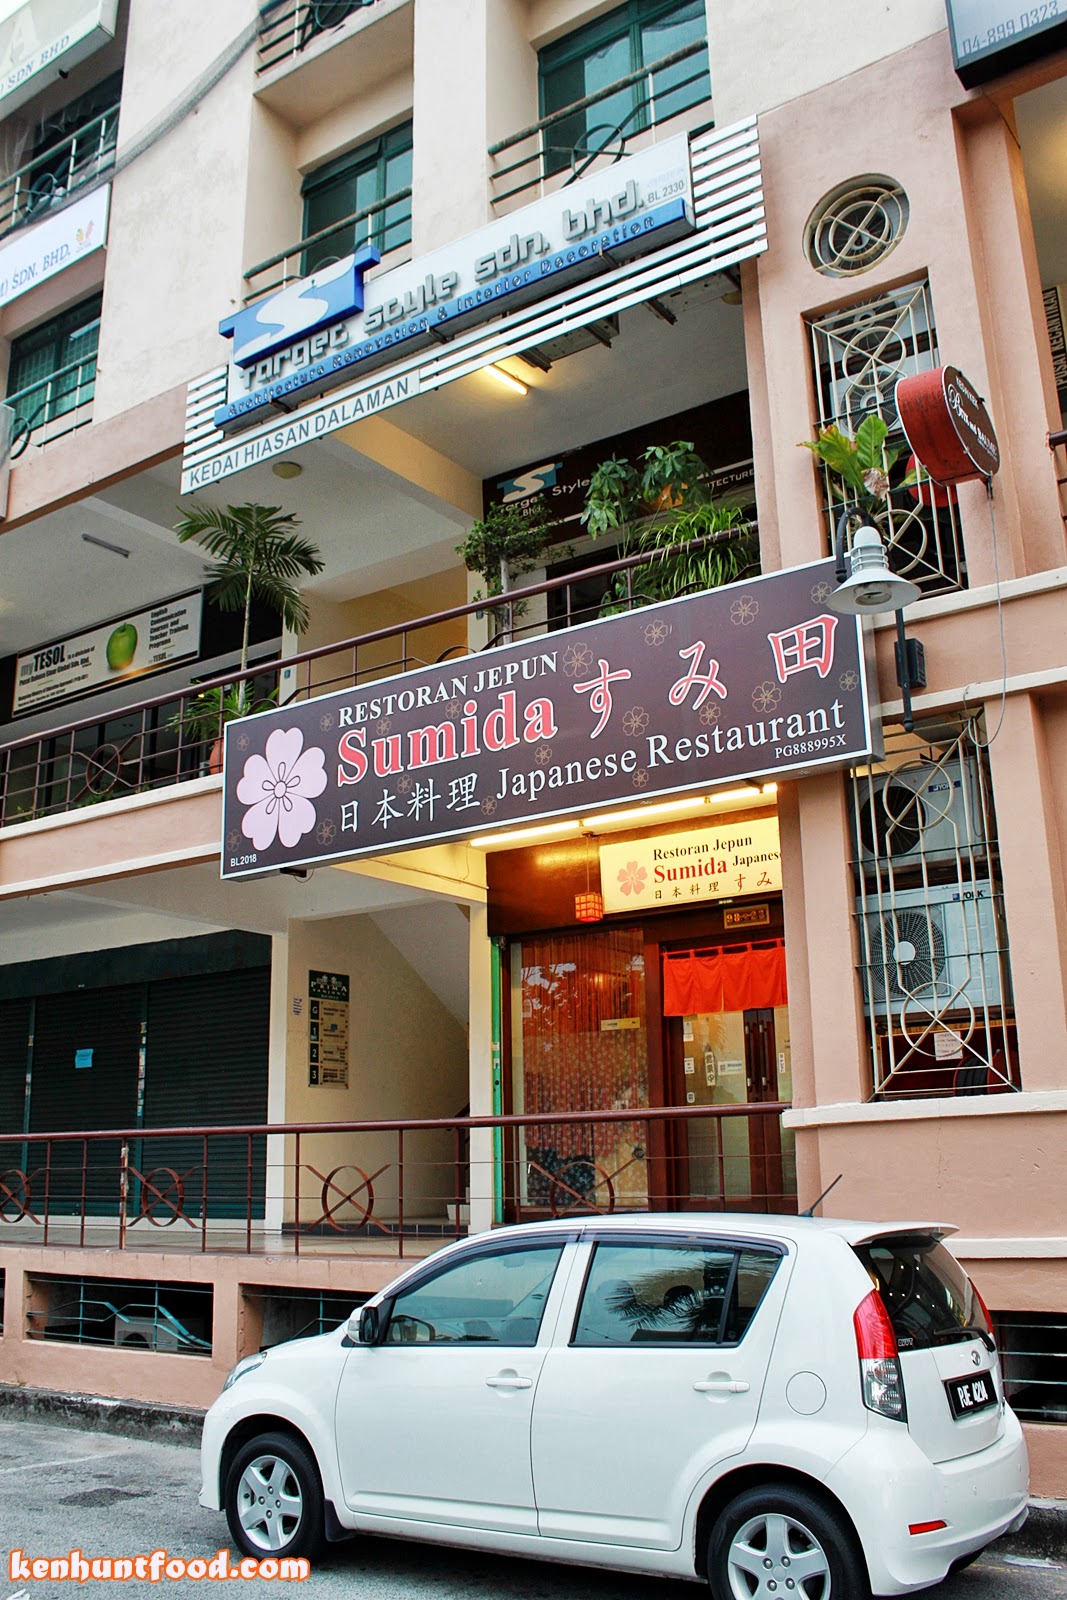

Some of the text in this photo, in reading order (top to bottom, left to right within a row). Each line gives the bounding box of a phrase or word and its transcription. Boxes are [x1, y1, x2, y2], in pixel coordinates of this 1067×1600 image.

[8, 60, 34, 88] SDN
[40, 35, 69, 64] BHD
[562, 179, 644, 240] bhd.
[648, 180, 685, 203] BL 2330
[12, 262, 38, 289] SDN.
[43, 243, 71, 271] BHD.
[228, 216, 654, 417] Architecture Renovation & Interior Decoration
[1043, 289, 1065, 351] KECANTIKAN
[190, 377, 409, 487] KEDAI HIASAN DALAMAN
[552, 478, 590, 496] Style
[338, 651, 558, 728] RESTORAN JEPUN
[573, 614, 838, 739] すみ田
[337, 690, 558, 787] Sumida
[496, 699, 845, 801] Japanese Restaurant
[775, 734, 846, 758] PG888995X
[340, 772, 481, 833] 日本料理
[230, 853, 257, 867] BL2018
[653, 836, 752, 861] Restoran Jepun
[654, 857, 728, 883] Sumida
[655, 881, 719, 899] 日本料理
[312, 1006, 318, 1014] G
[312, 1049, 317, 1057] 2
[312, 1071, 317, 1079] 3
